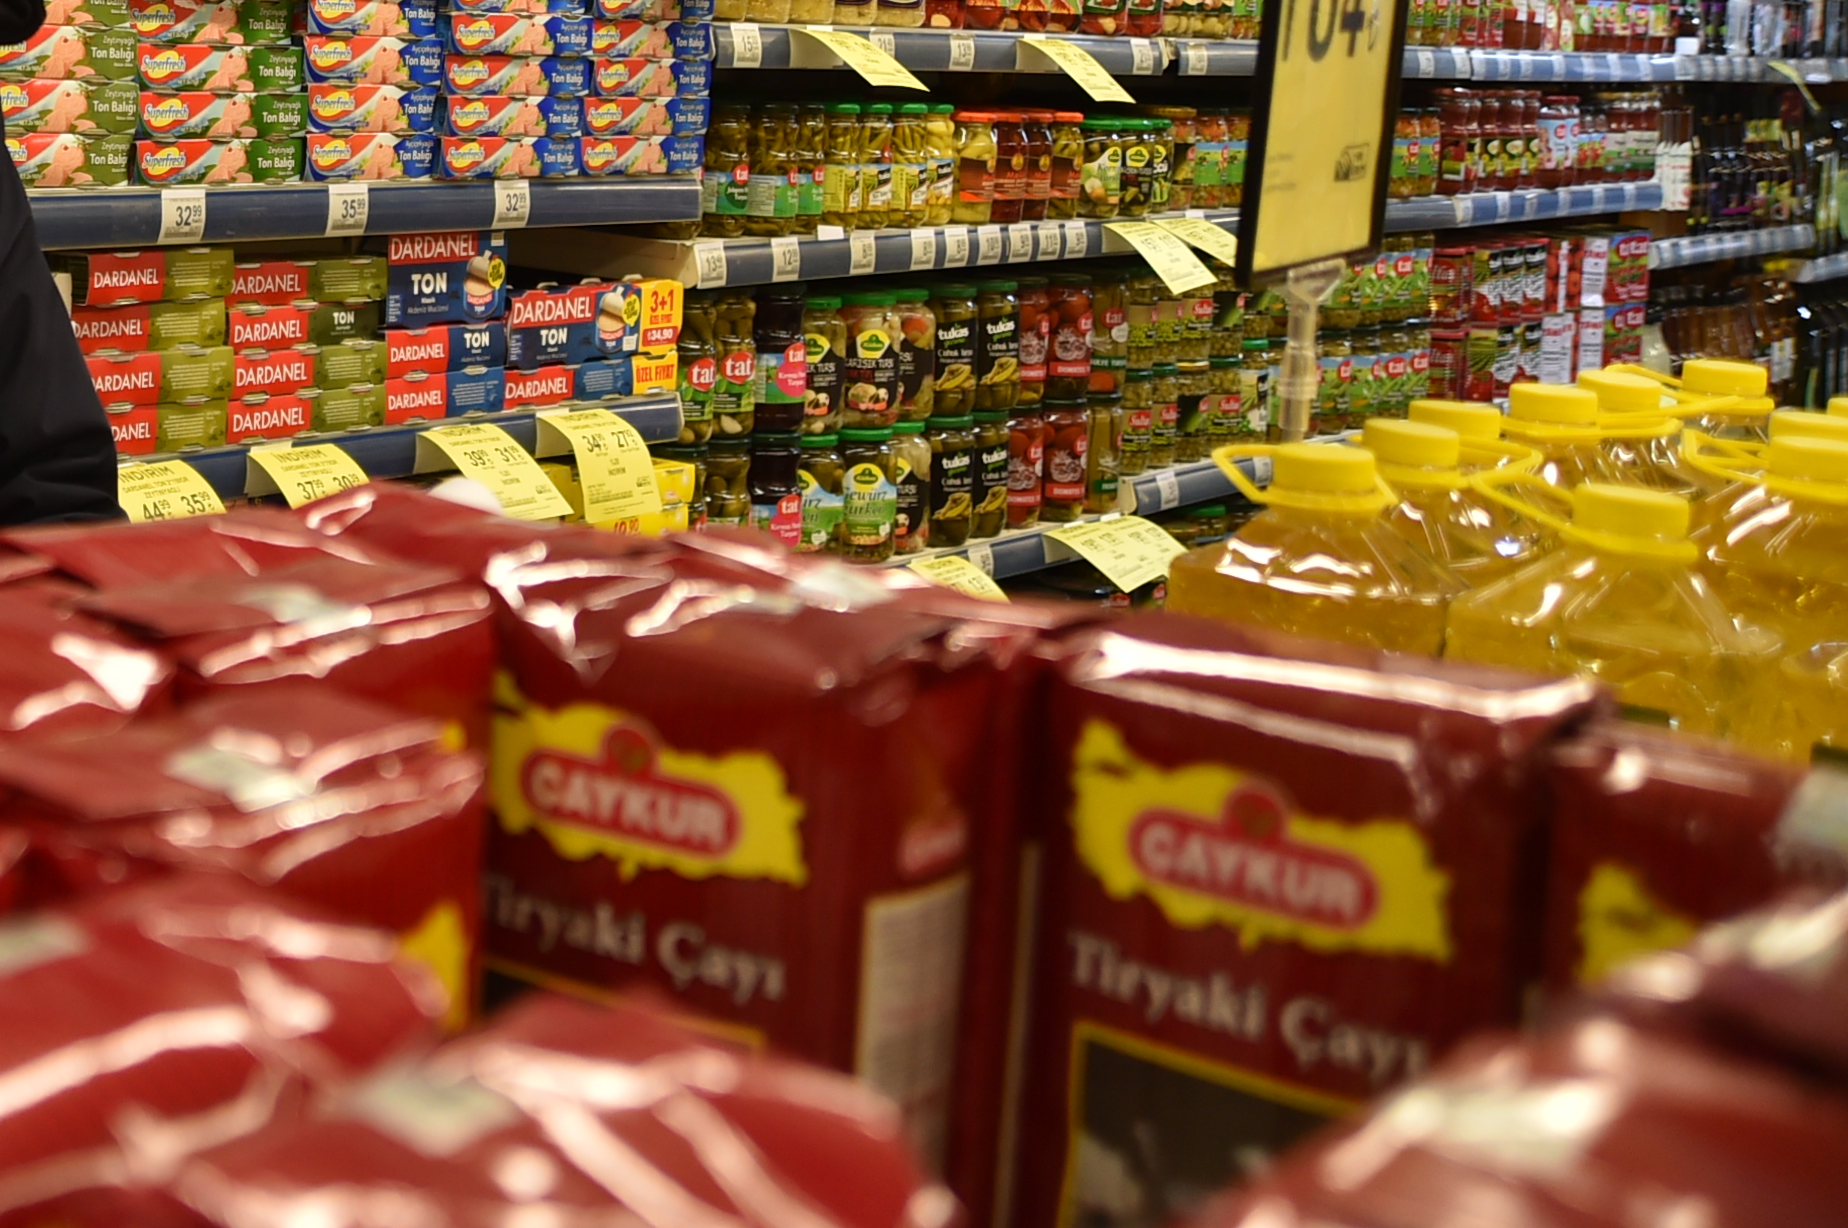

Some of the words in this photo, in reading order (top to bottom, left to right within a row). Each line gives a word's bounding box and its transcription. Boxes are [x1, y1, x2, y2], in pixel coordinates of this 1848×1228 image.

[131, 8, 176, 24] Superfresh
[405, 8, 417, 18] Ton
[248, 19, 263, 30] Ton
[556, 33, 566, 43] Ton
[91, 47, 107, 59] Ton
[405, 56, 419, 66] Ton
[141, 55, 186, 72] Superfresh
[259, 66, 273, 78] Ton
[552, 73, 562, 83] Ton
[93, 100, 109, 112] Ton
[144, 103, 189, 120] Superfresh
[404, 104, 417, 114] Ton
[262, 112, 278, 123] Ton
[90, 153, 105, 165] Ton
[142, 151, 186, 169] Superfresh
[257, 157, 272, 169] Ton
[399, 150, 411, 161] Ton
[341, 199, 357, 219] 35
[506, 193, 518, 212] 32
[175, 205, 192, 226] 32
[192, 205, 202, 217] 99
[390, 234, 476, 261] DARDANEL
[1630, 238, 1648, 253] tat
[94, 268, 159, 289] DARDANEL
[411, 272, 448, 296] TON
[650, 289, 675, 313] 3+1
[333, 311, 355, 325] TON
[513, 297, 592, 324] DARDANEL
[74, 319, 143, 338] DARDANEL
[234, 319, 302, 343] DARDANEL
[540, 328, 568, 346] TON
[464, 331, 490, 349] TON
[390, 343, 445, 363] DARDANEL
[788, 348, 804, 363] tat
[236, 362, 308, 387] DARDANEL
[636, 364, 653, 384] ÖZEL
[692, 366, 715, 384] tat
[725, 357, 753, 377] tat
[505, 377, 568, 399] DARDANEL
[388, 390, 443, 411] DARDANEL
[233, 407, 305, 433] DARDANEL
[581, 434, 601, 453] 34
[611, 431, 627, 449] 27
[297, 481, 316, 501] 37
[180, 495, 201, 515] 35
[781, 500, 799, 514] tat
